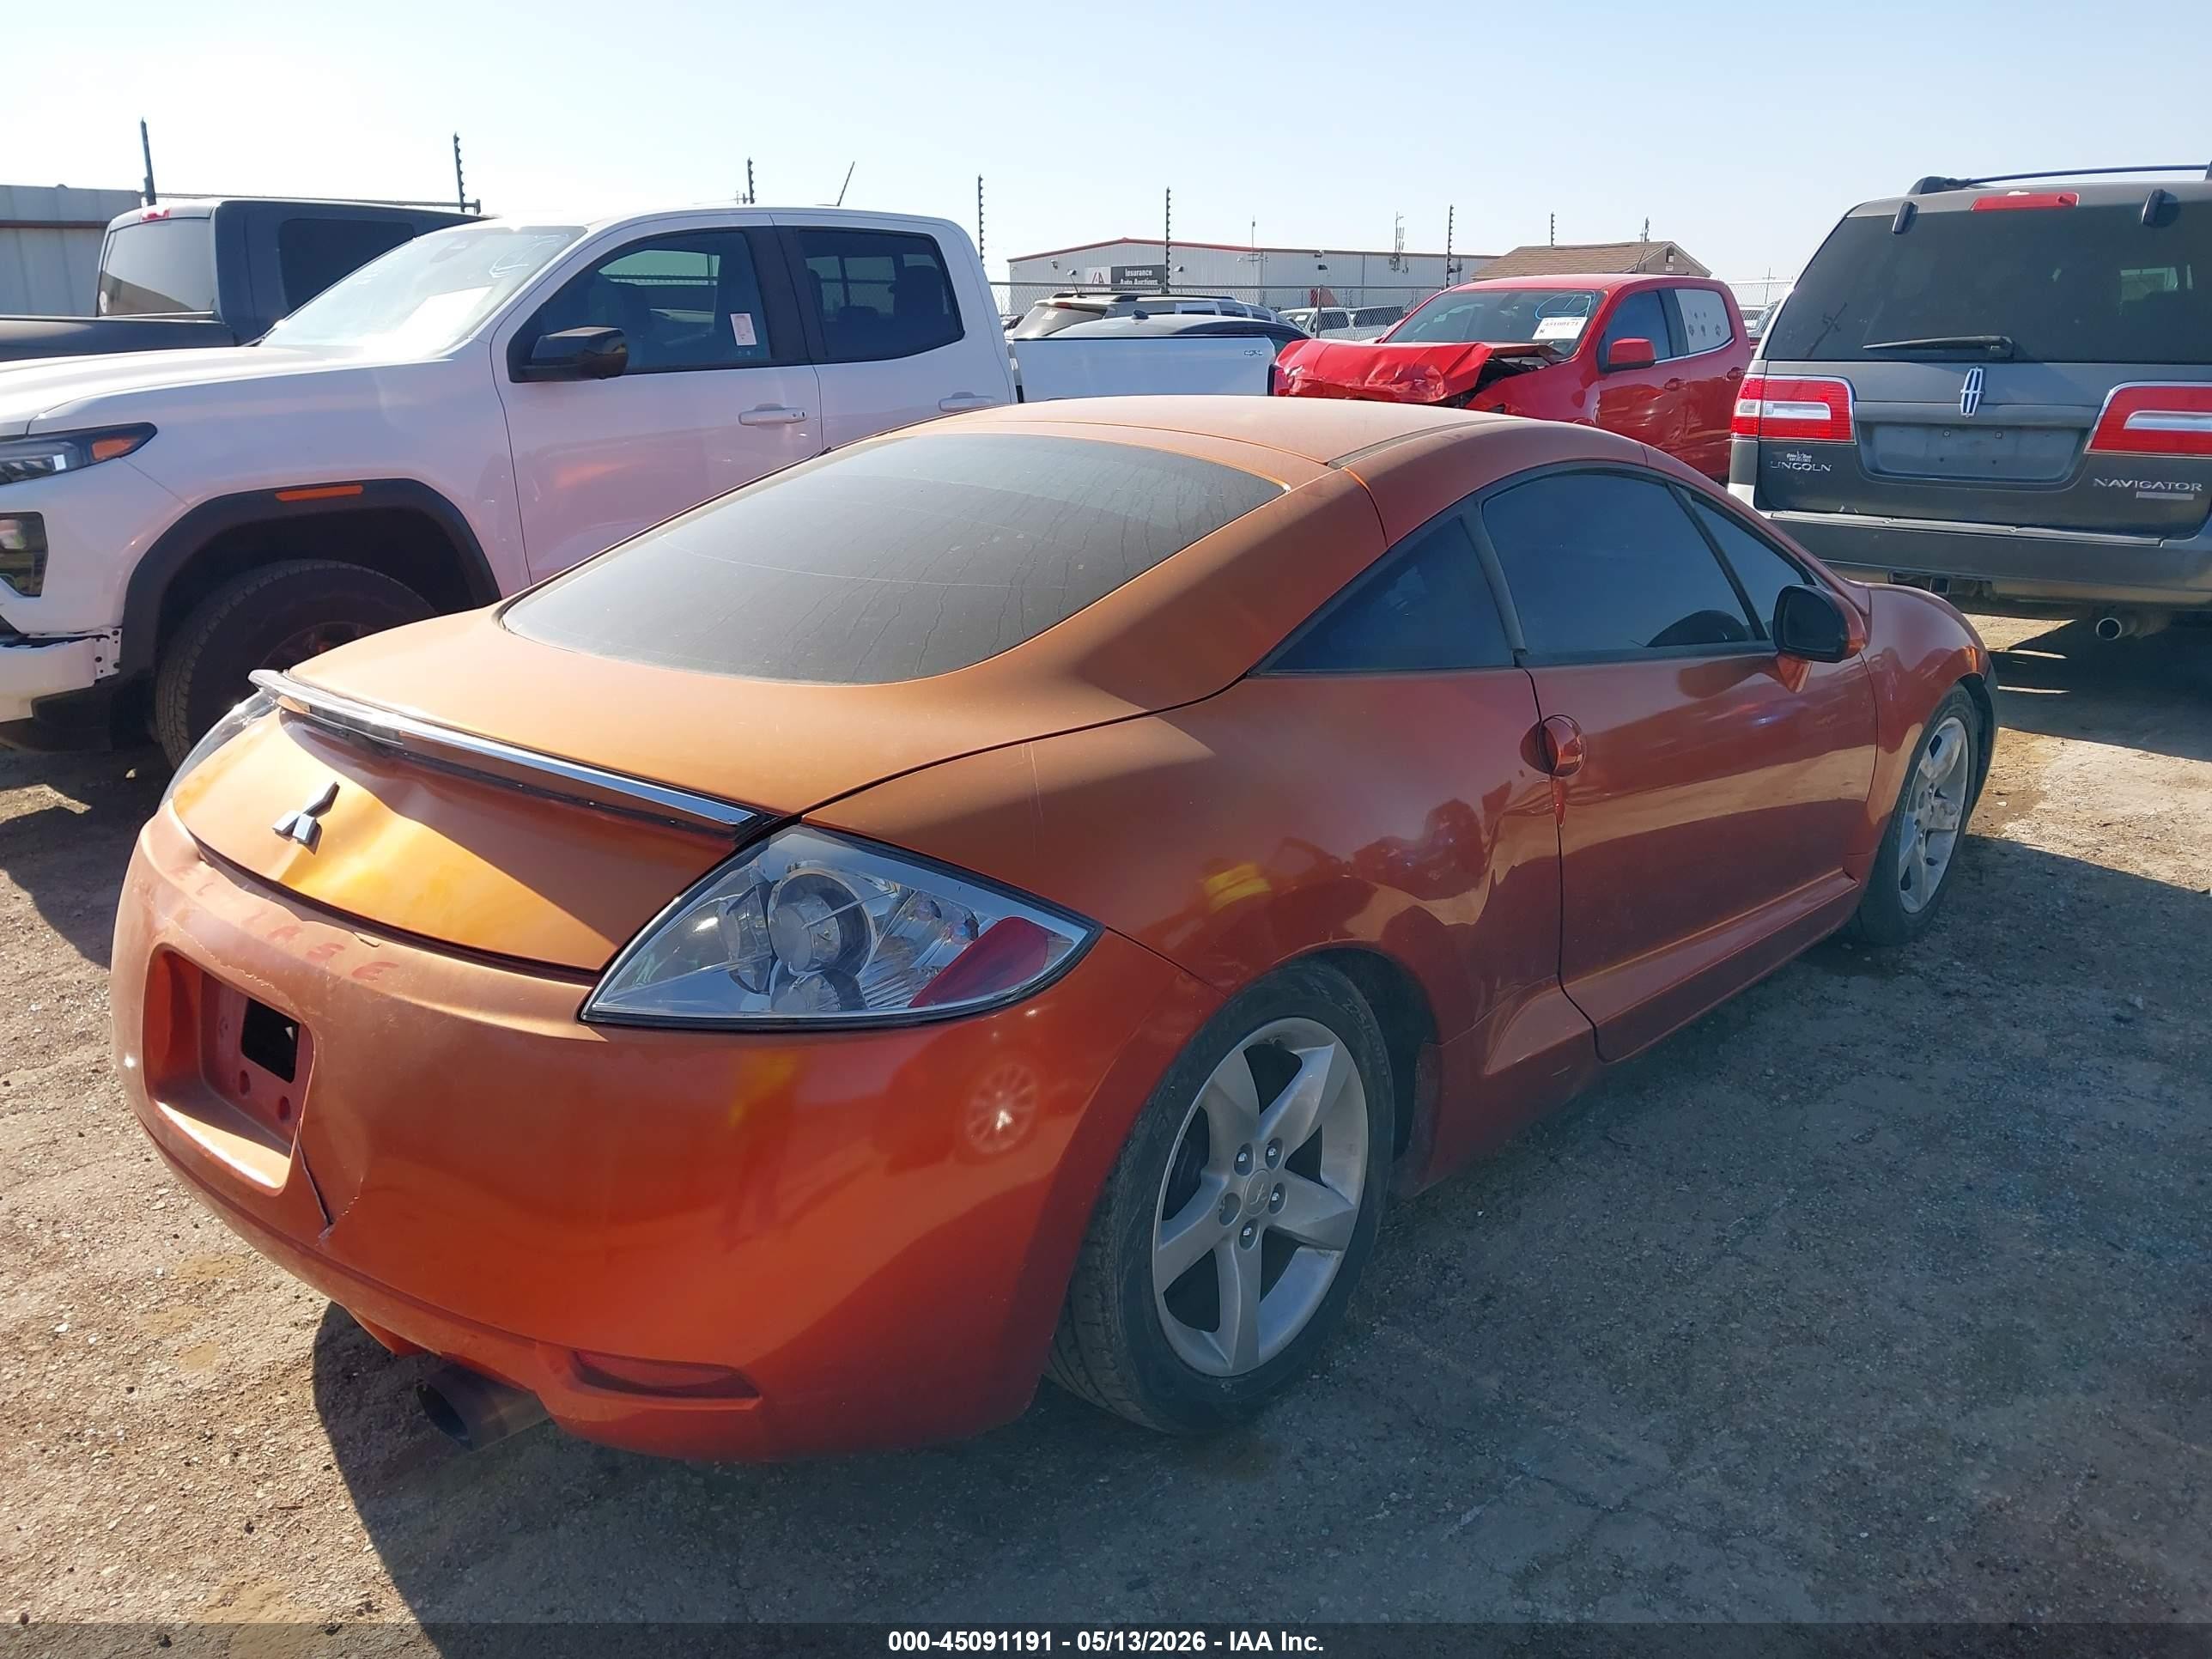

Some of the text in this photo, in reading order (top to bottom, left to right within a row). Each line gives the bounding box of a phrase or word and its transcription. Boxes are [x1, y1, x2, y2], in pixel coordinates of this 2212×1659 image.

[1125, 268, 1153, 276] Insurance
[1771, 461, 1832, 471] LINCOLN
[2094, 477, 2203, 491] NAVIGATOR
